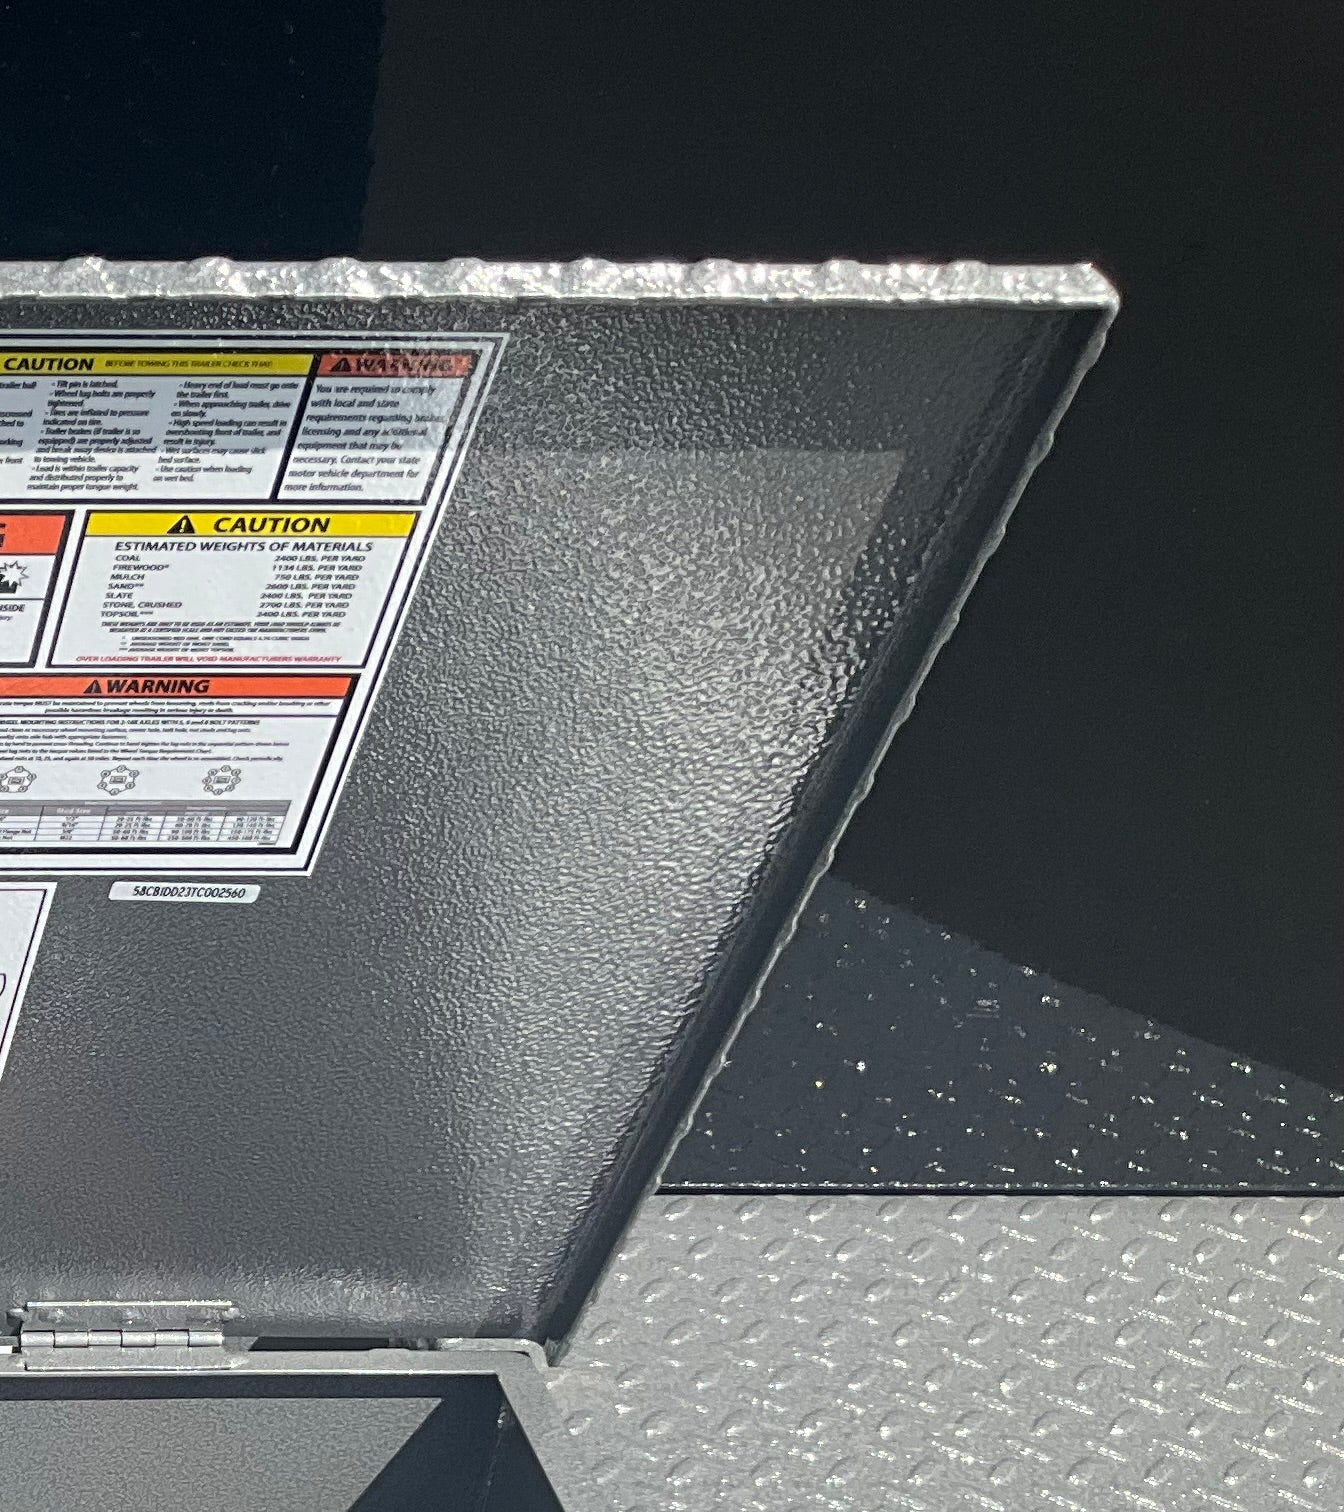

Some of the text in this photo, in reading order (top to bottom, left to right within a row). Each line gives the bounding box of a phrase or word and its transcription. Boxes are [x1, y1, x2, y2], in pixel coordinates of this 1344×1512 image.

[2, 357, 95, 371] CAUTION
[355, 356, 453, 374] WARNING
[212, 516, 331, 533] CAUTION
[114, 540, 373, 552] ESTIMATED WEIGHTS OF MATERIALS
[106, 678, 210, 694] WARNING
